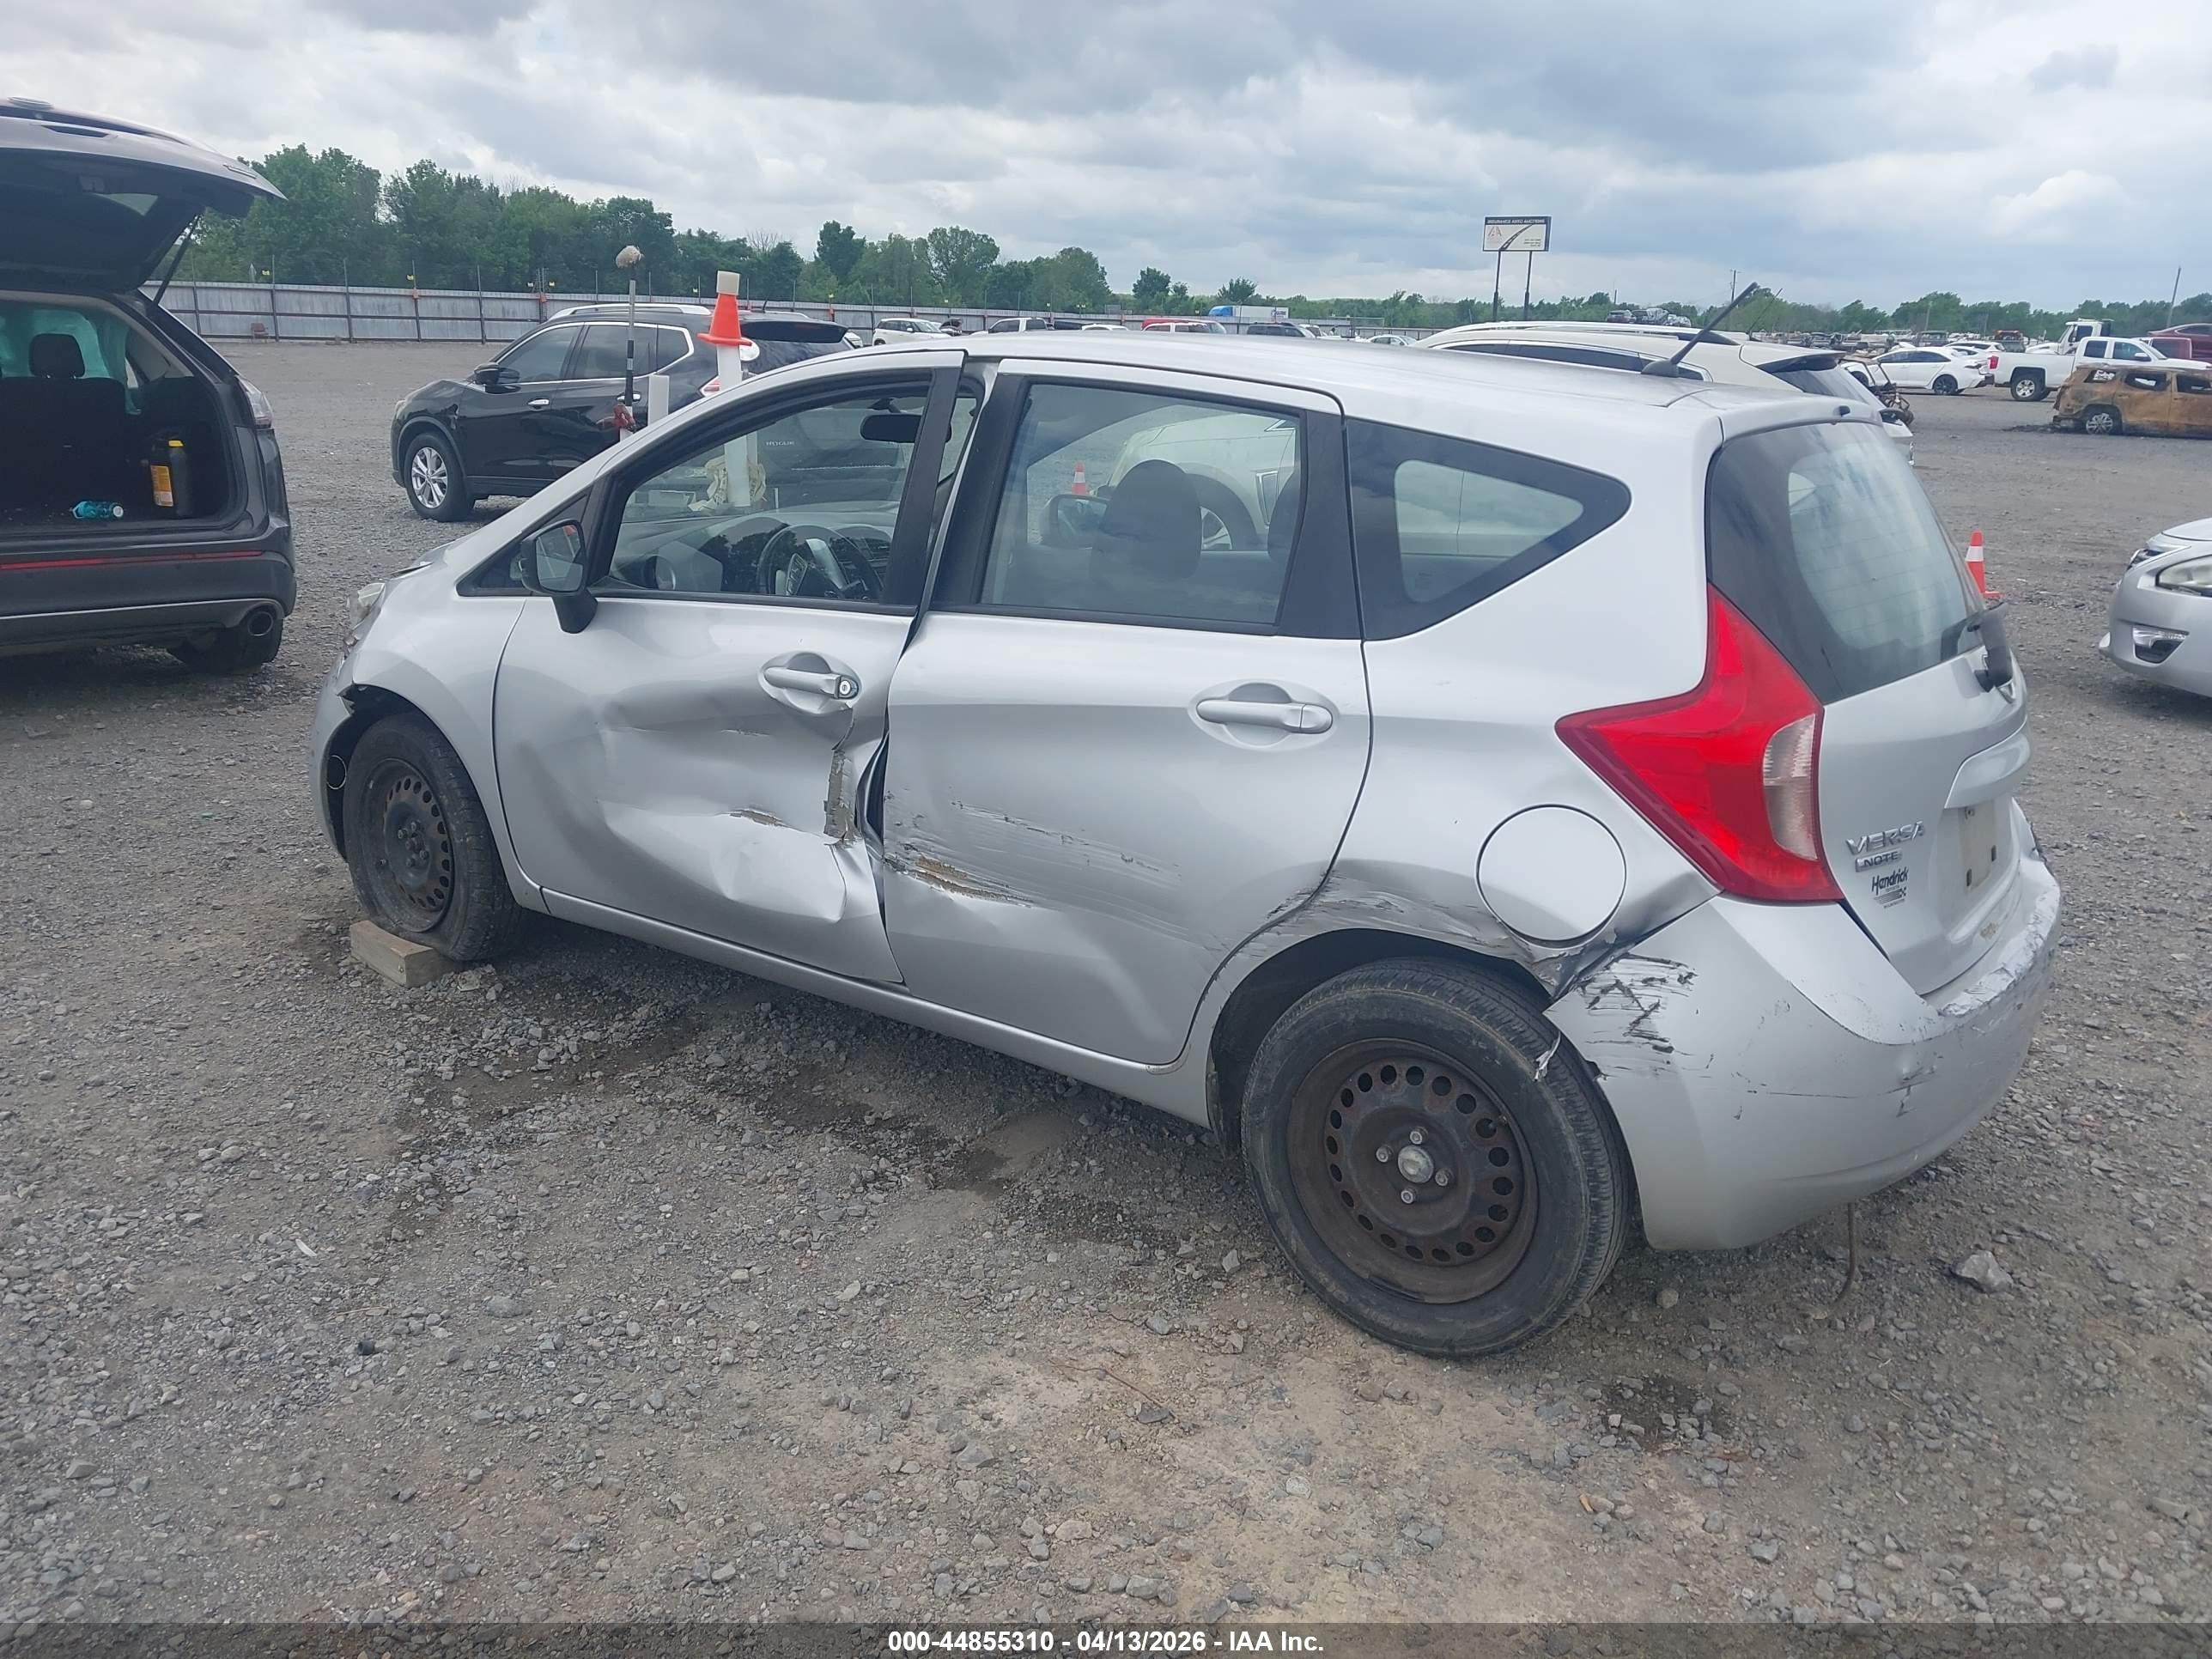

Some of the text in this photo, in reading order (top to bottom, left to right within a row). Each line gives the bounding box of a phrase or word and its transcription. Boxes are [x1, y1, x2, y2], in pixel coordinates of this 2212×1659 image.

[1845, 820, 1924, 856] VERSA
[1863, 850, 1899, 866] NOTE
[1871, 866, 1910, 896] Hendrick
